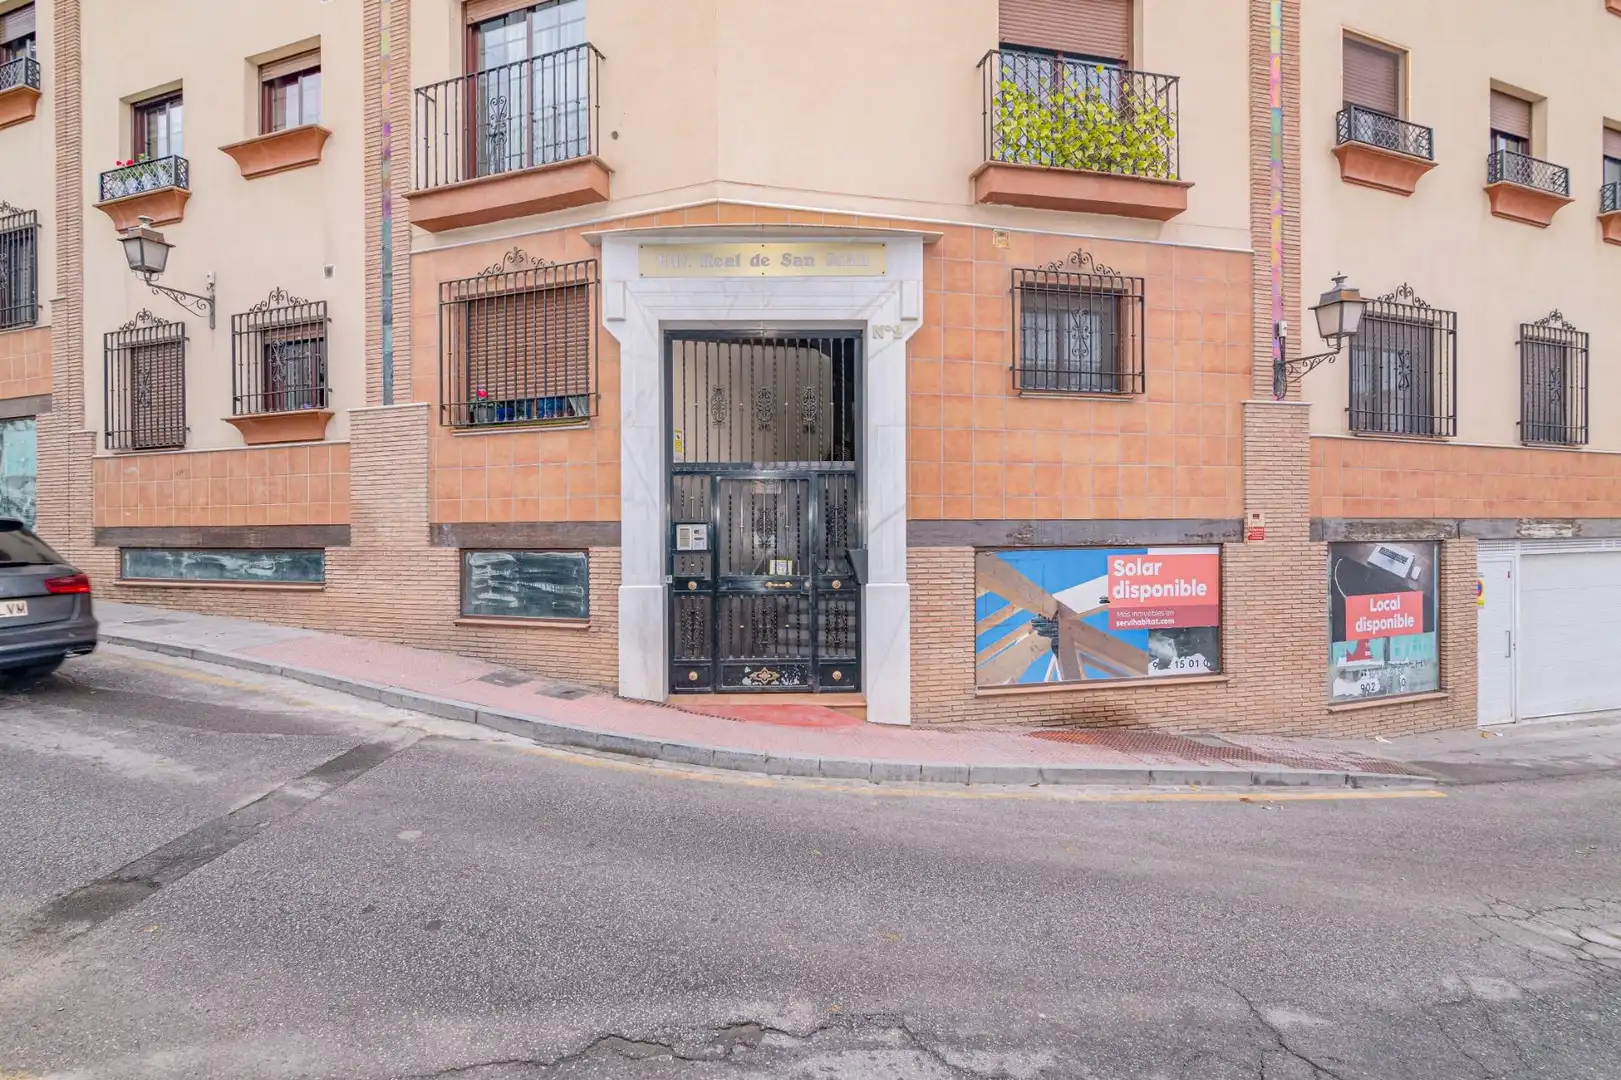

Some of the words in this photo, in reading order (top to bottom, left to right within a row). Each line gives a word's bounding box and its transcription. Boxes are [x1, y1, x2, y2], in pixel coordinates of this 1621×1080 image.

[701, 252, 741, 267] Real
[749, 252, 771, 267] de
[780, 252, 815, 267] San
[1113, 558, 1162, 576] Solar
[1113, 579, 1207, 603] disponible
[1370, 595, 1401, 612] Local
[1116, 619, 1175, 627] servihabitat.com
[1355, 613, 1415, 634] disponible
[1175, 660, 1185, 669] 15
[1188, 659, 1199, 668] 01
